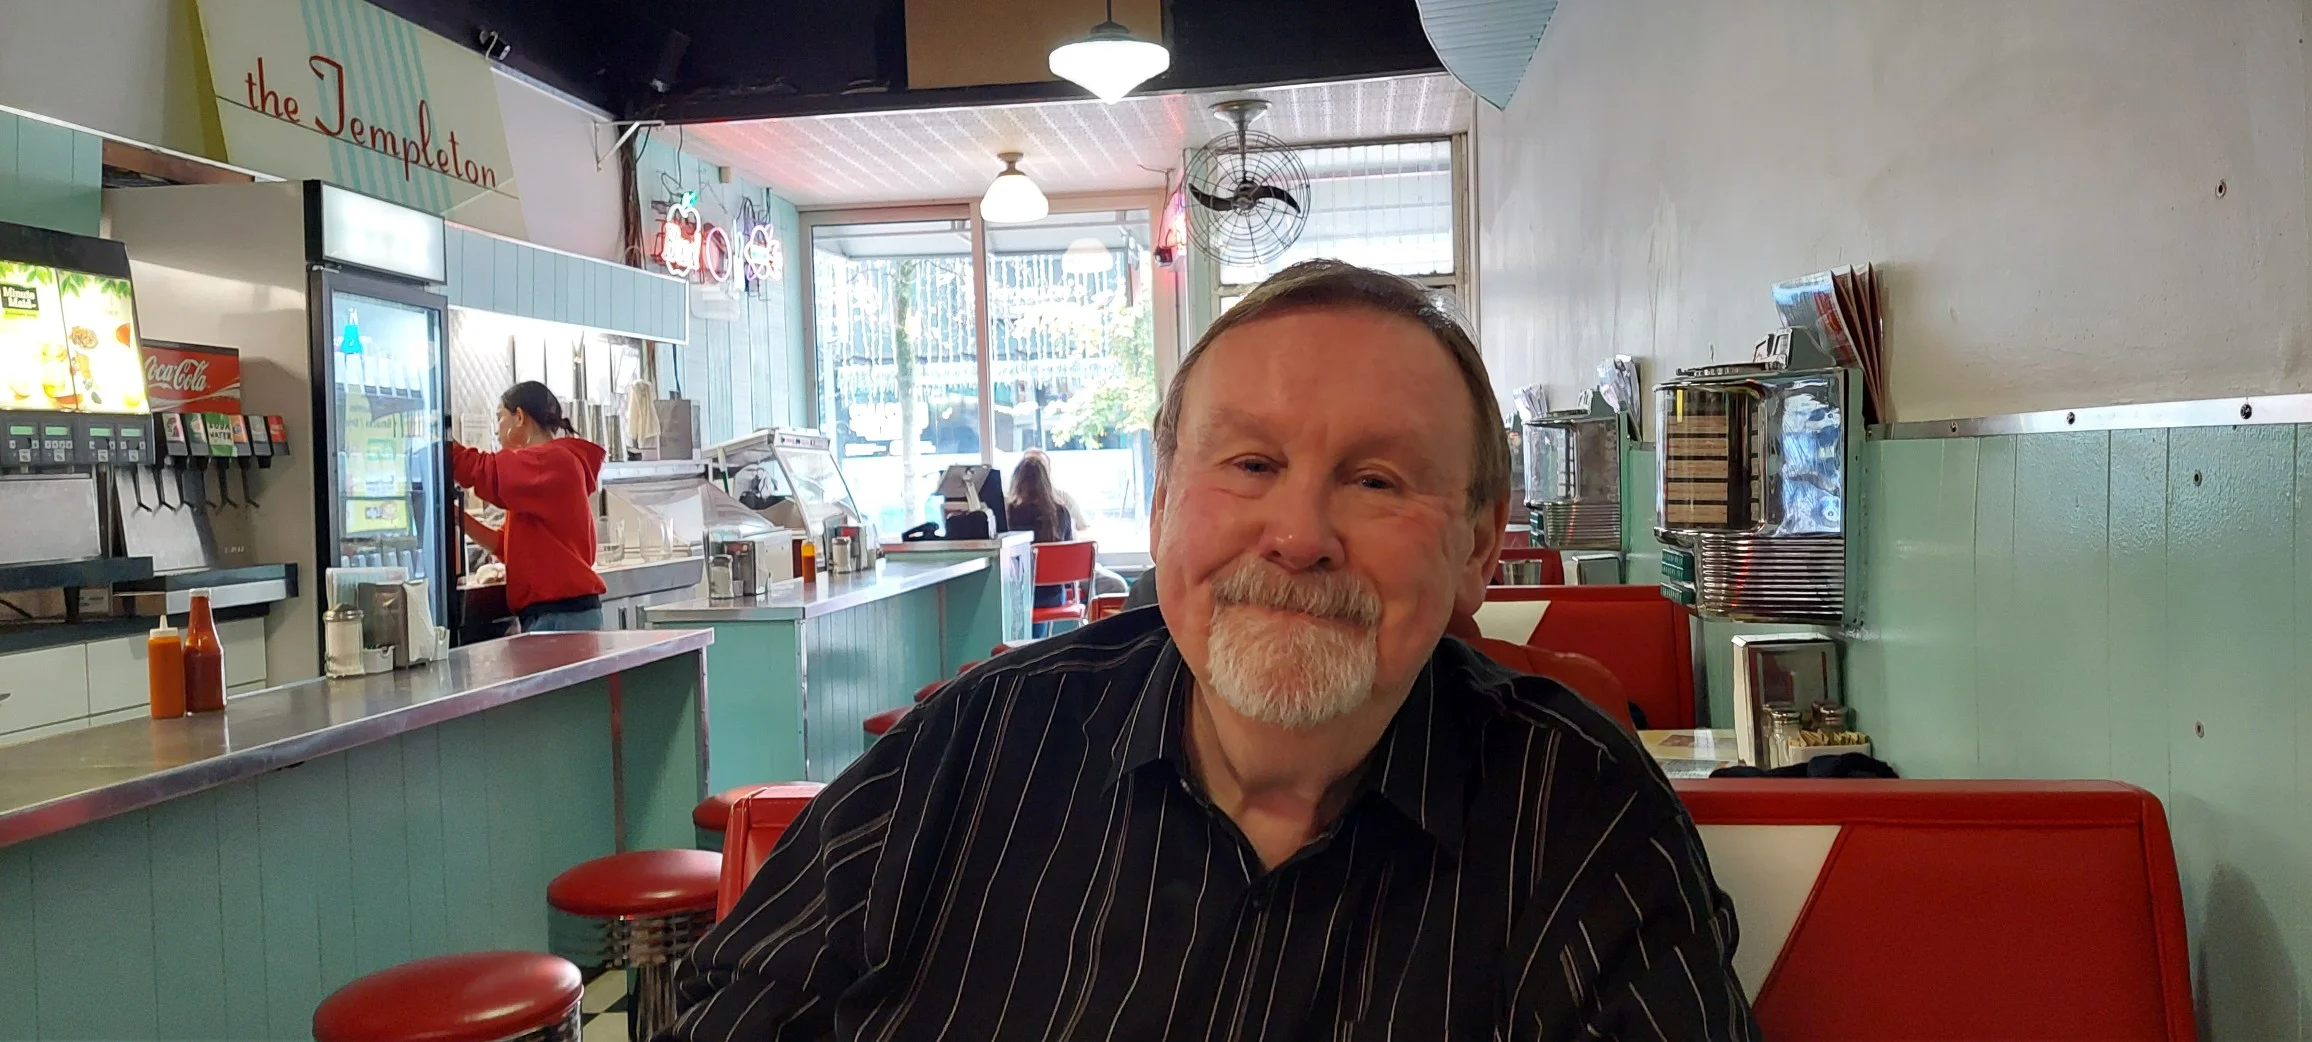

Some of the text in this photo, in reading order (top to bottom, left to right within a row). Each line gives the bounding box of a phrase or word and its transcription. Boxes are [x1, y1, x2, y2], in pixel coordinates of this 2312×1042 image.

[244, 55, 497, 188] the Templeton
[2, 286, 36, 300] Minute
[8, 297, 32, 309] Maid
[144, 355, 209, 392] Coca-Cola
[209, 431, 232, 440] WATER
